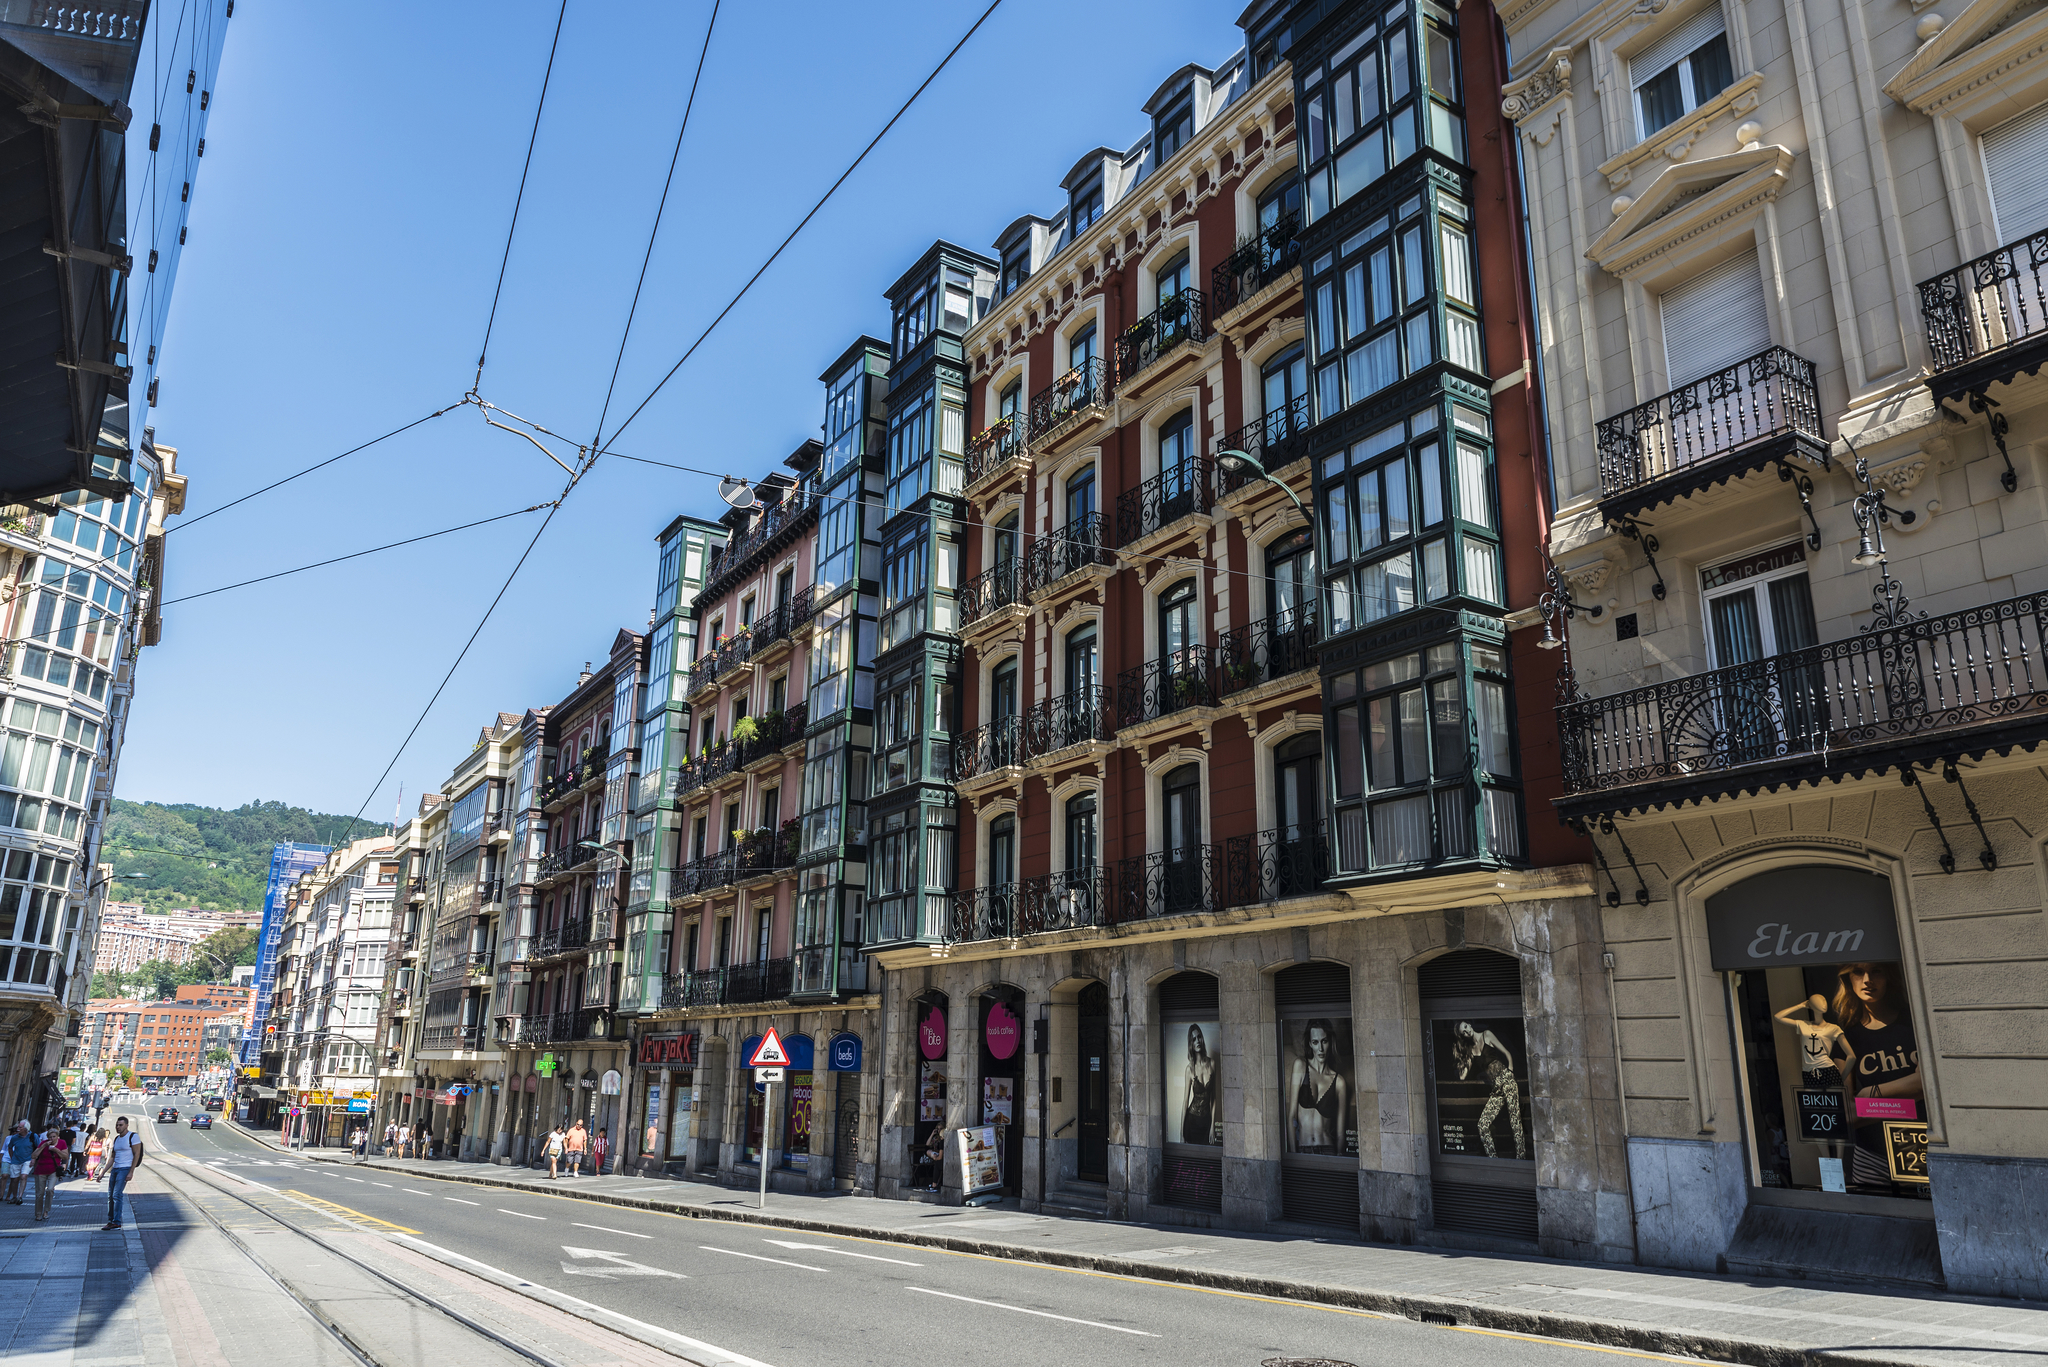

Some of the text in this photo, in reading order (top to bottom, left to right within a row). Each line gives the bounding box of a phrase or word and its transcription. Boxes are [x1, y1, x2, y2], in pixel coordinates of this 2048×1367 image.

[1746, 922, 1865, 959] Etam
[923, 1025, 934, 1036] The
[1000, 1026, 1014, 1035] coffee
[664, 1033, 693, 1064] YORK
[1802, 1094, 1838, 1106] BIKINI
[1443, 1124, 1464, 1132] etam.es
[1810, 1113, 1838, 1132] 20€
[1893, 1131, 1909, 1143] EL
[1896, 1151, 1927, 1172] 12€
